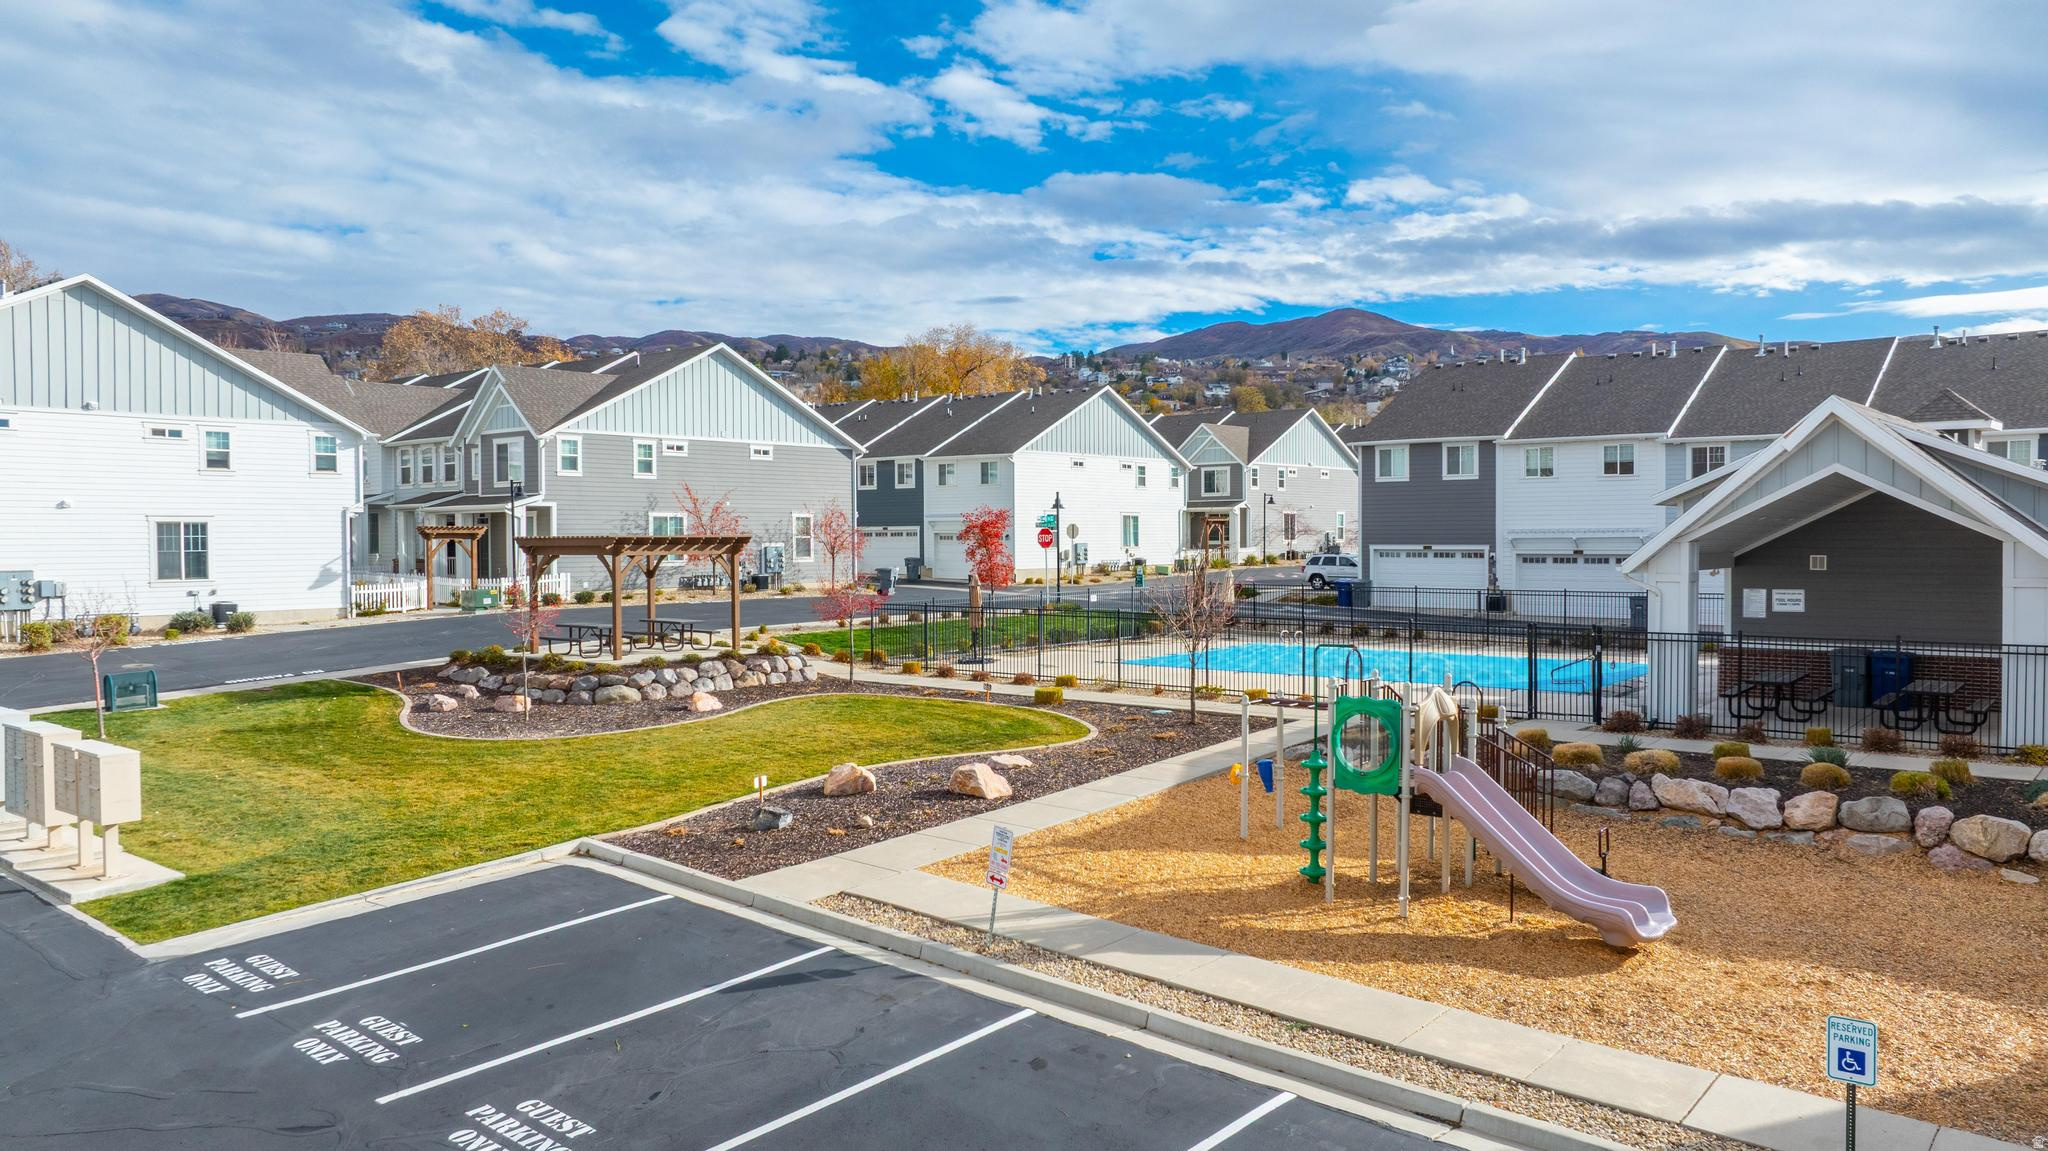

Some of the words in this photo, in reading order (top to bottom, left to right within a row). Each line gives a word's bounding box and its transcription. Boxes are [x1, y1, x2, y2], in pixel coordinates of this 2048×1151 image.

[204, 958, 276, 993] PARKING
[245, 955, 300, 980] GUEST
[182, 973, 231, 994] ONLY
[313, 1019, 400, 1063] PARKING
[359, 1015, 424, 1046] GUEST
[1830, 1021, 1874, 1037] RESERVED
[1833, 1033, 1871, 1048] PARKING
[292, 1038, 350, 1065] ONLY
[464, 1104, 573, 1151] PARKIN
[515, 1100, 597, 1139] GUEST
[448, 1129, 509, 1151] ON
